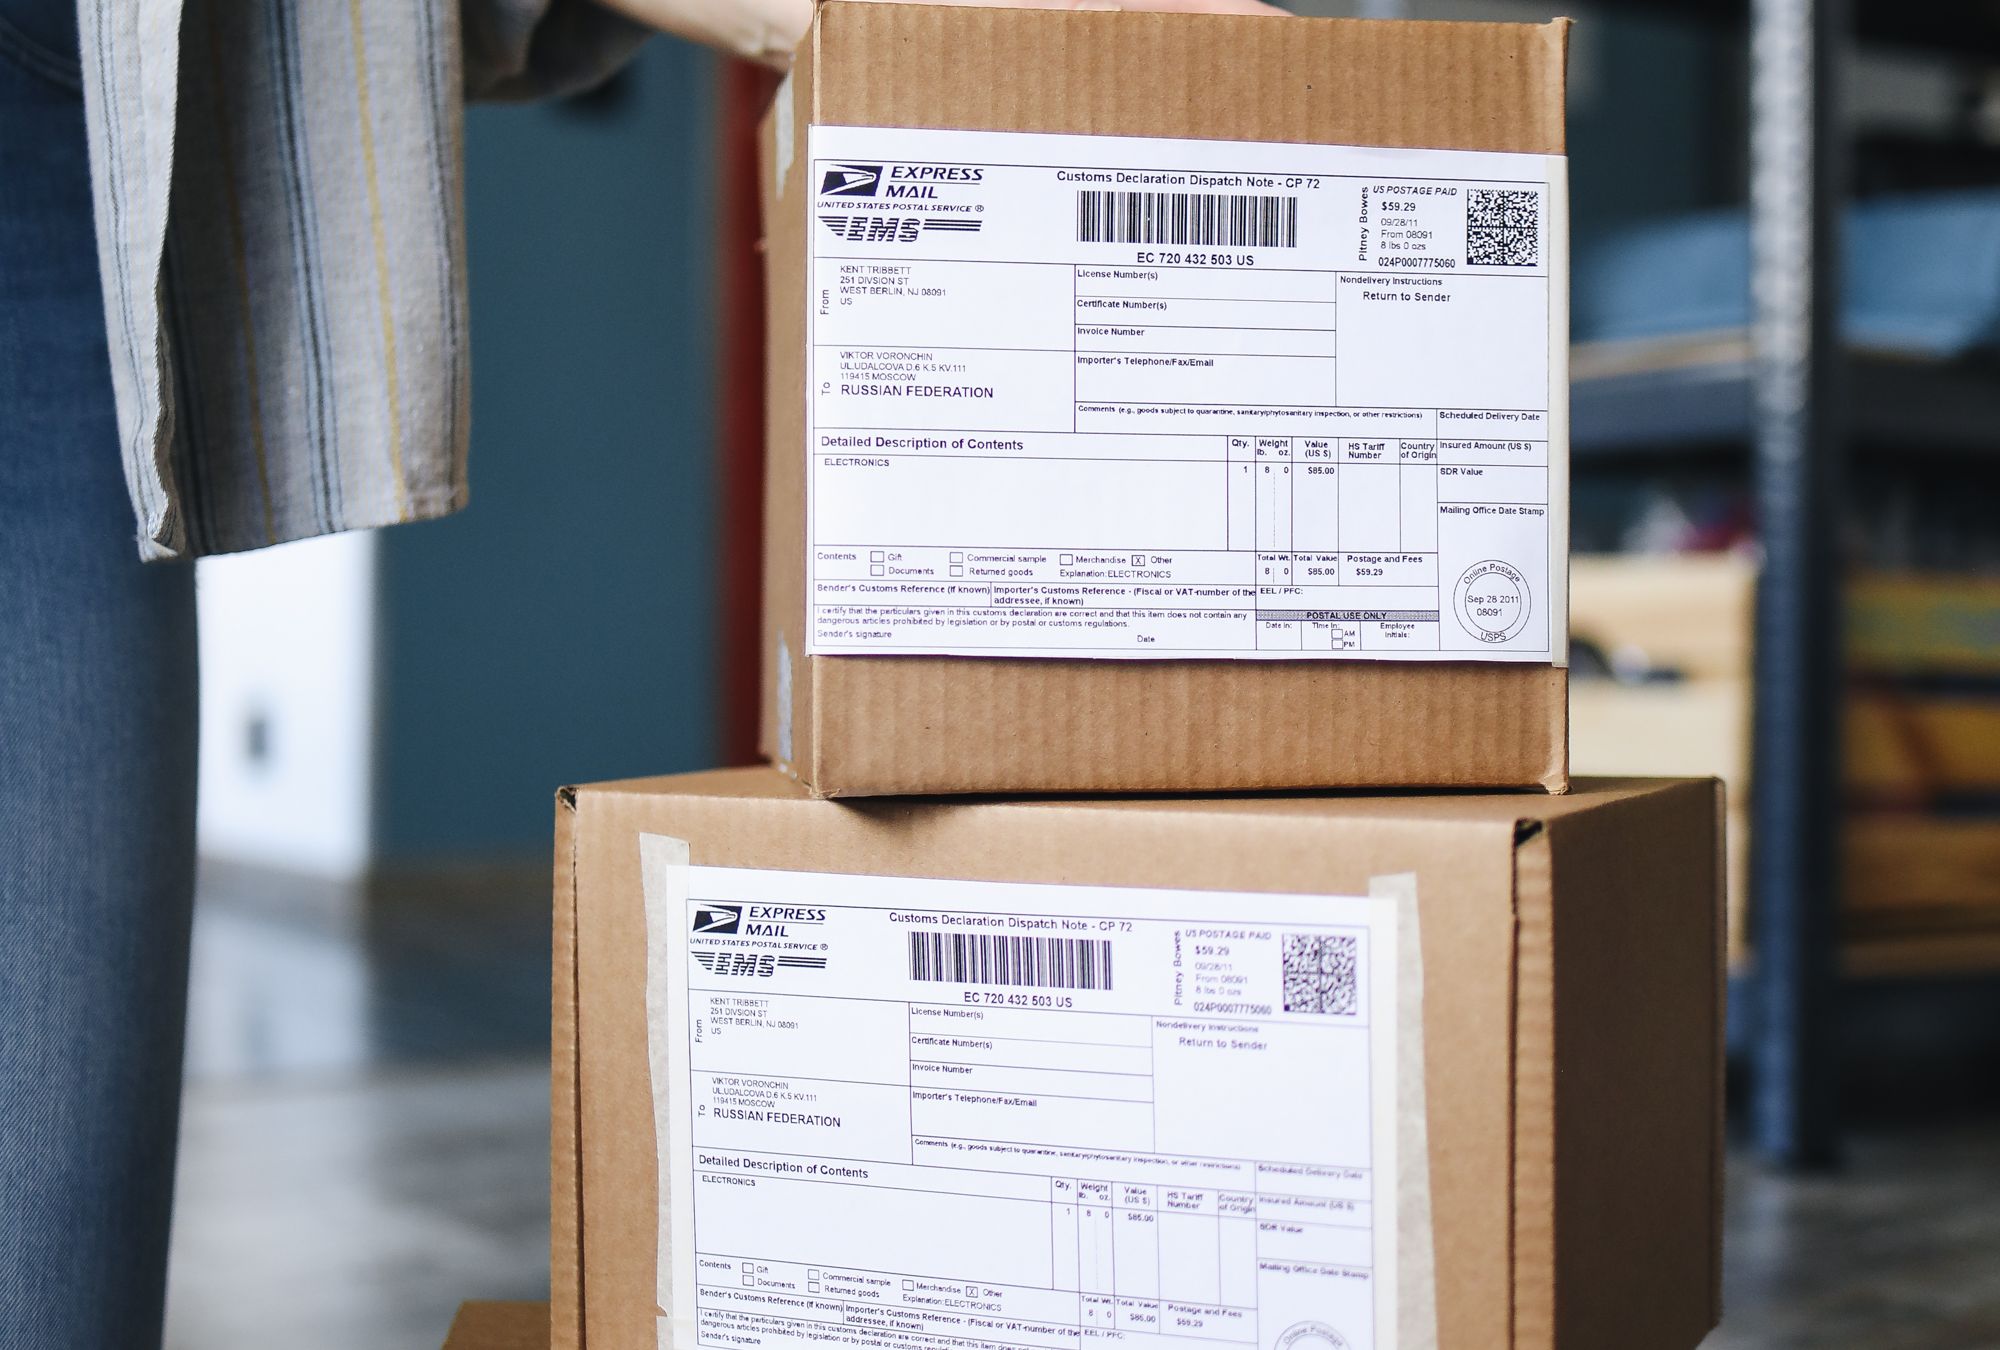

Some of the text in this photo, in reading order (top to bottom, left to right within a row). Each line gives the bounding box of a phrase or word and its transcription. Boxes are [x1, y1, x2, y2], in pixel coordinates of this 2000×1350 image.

[891, 166, 984, 180] EXPRESS
[1057, 171, 1112, 182] Customs
[1117, 172, 1184, 184] Declaration
[1190, 175, 1242, 188] Dispatch
[1247, 177, 1274, 187] Note
[1286, 178, 1302, 188] CP
[1307, 178, 1320, 188] 72
[886, 185, 938, 198] MAIL
[1386, 186, 1432, 195] POSTAGE
[1435, 188, 1457, 196] PAID
[1382, 202, 1416, 211] $59.29
[1359, 187, 1369, 261] Pitney Bowes
[1381, 218, 1417, 226] 09/28/11
[847, 217, 920, 242] EMS
[1381, 230, 1432, 239] From 08091
[1138, 252, 1254, 266] EC 720 432 503 US
[1378, 257, 1455, 268] 024P0007775060
[867, 266, 911, 274] TRIBBETT
[1078, 270, 1158, 280] License Number(s)
[840, 276, 854, 284] 251
[858, 276, 894, 284] DIVSION
[1340, 276, 1442, 286] Nondelivery Instructions
[840, 286, 867, 294] WEST
[870, 287, 904, 296] BERLIN,
[922, 288, 945, 296] 08091
[820, 290, 829, 314] From
[1364, 292, 1450, 302] Return to Sender
[1077, 300, 1167, 310] Certificate Number(s)
[1111, 328, 1144, 336] Number
[876, 352, 932, 360] VORONCHIN
[1078, 356, 1213, 366] Importer's Telephone/Fax/Email
[841, 372, 870, 380] 119415
[822, 382, 830, 396] To
[842, 384, 993, 398] RUSSIAN FEDERATION
[1486, 412, 1519, 422] Delivery
[822, 436, 1023, 450] Detailed Description of Contents
[1232, 439, 1249, 448] Qty.
[1259, 440, 1288, 448] Weight
[1305, 440, 1328, 448] Value
[1401, 442, 1435, 452] Country
[1508, 443, 1521, 451] (US
[1524, 443, 1531, 451] $)
[1305, 450, 1331, 458] (US $)
[1412, 452, 1437, 460] Origin
[825, 458, 889, 466] ELECTRONICS
[1440, 506, 1470, 515] Mailing
[1519, 508, 1544, 516] Stamp
[967, 554, 1046, 564] Commercial sample
[1348, 555, 1381, 564] Postage
[1356, 568, 1383, 576] $59.29
[1468, 595, 1484, 604] Sep
[1306, 612, 1386, 620] POSTAL USE ONLY
[749, 906, 826, 922] EXPRESS
[890, 912, 938, 924] Customs
[942, 915, 1004, 926] Declaration
[1009, 918, 1057, 930] Dispatch
[1062, 920, 1087, 930] Note
[1100, 921, 1115, 930] CP
[1120, 922, 1132, 932] 72
[746, 924, 788, 937] MAIL
[714, 953, 775, 977] EMS
[732, 998, 768, 1007] TRIBBETT
[964, 992, 1072, 1008] EC 720 432 503 US
[725, 1008, 755, 1016] DIVSION
[736, 1018, 764, 1027] BERLIN,
[766, 1020, 775, 1028] NJ
[778, 1021, 798, 1029] 08091
[1179, 1037, 1267, 1050] Return to Sender
[714, 1108, 840, 1127] RUSSIAN FEDERATION
[699, 1155, 868, 1178] Detailed Description of Contents
[702, 1175, 755, 1186] ELECTRONICS
